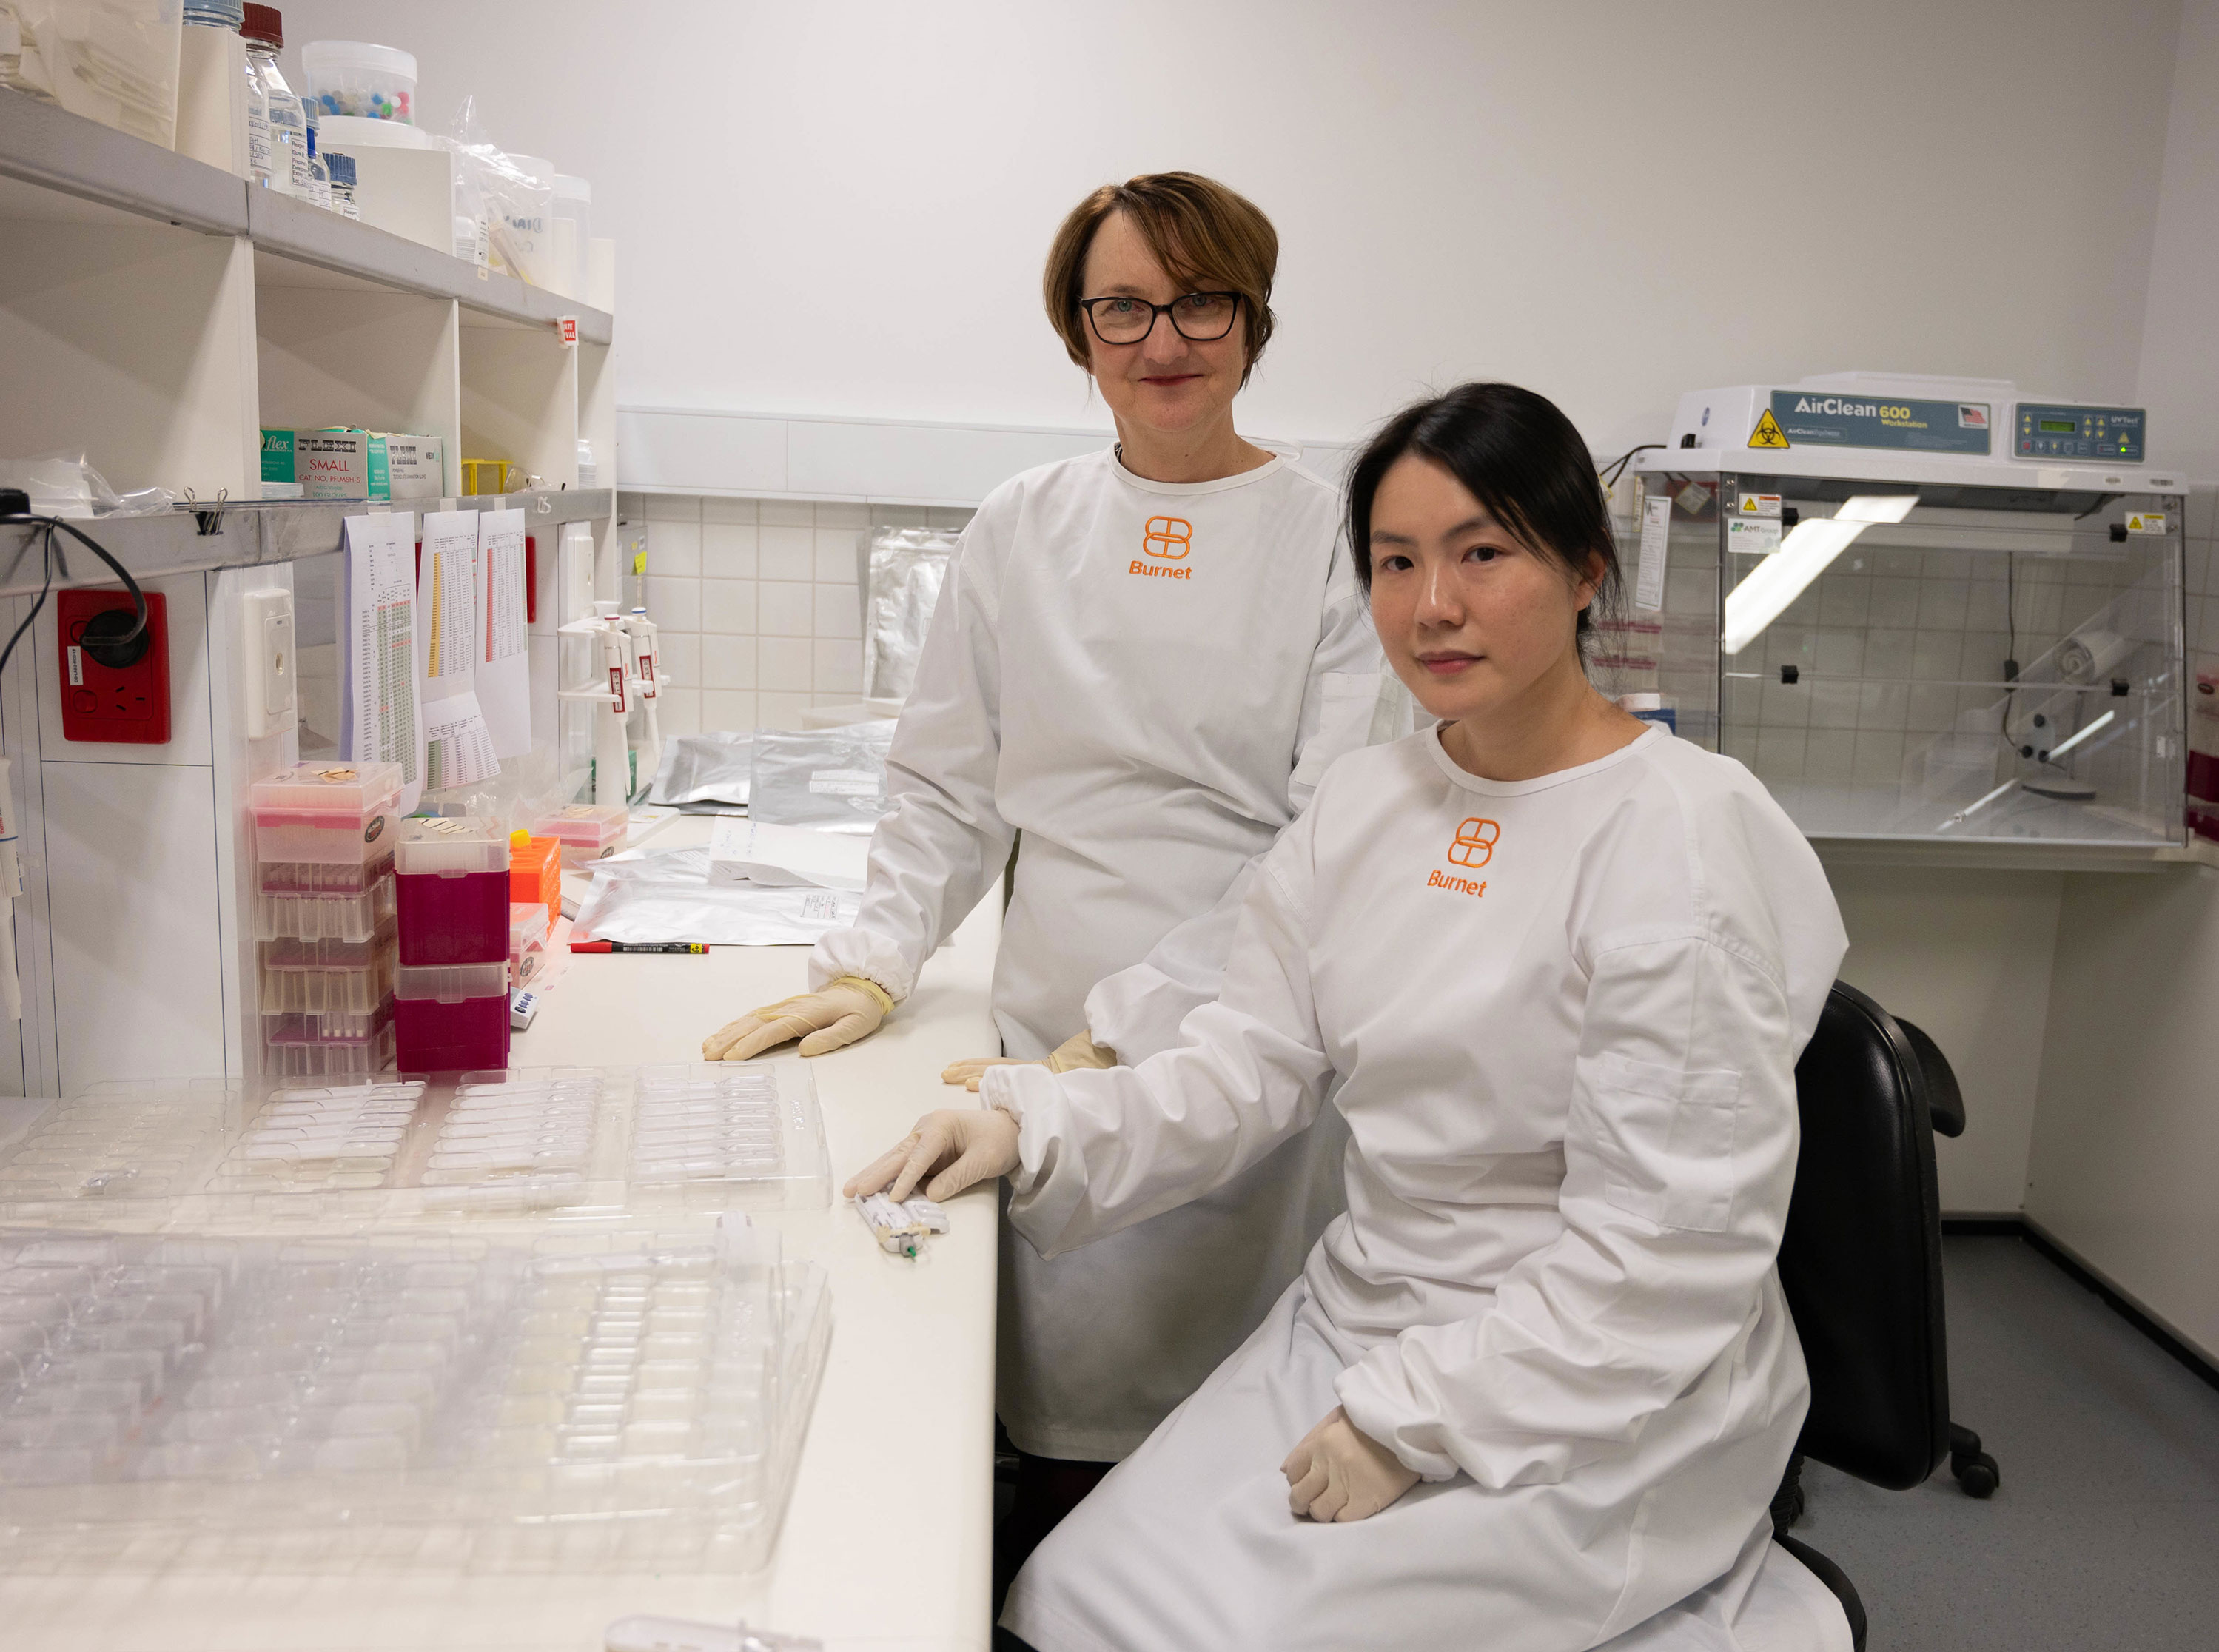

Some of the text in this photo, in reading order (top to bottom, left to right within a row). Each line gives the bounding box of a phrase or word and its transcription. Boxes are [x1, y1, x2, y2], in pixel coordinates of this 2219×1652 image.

[1794, 397, 1911, 420] AirClean 600
[1881, 418, 1928, 429] Workstation
[298, 439, 356, 453] FLEXI
[309, 458, 349, 471] SMALL
[1129, 560, 1192, 580] Burnet
[1427, 870, 1487, 897] Burnet
